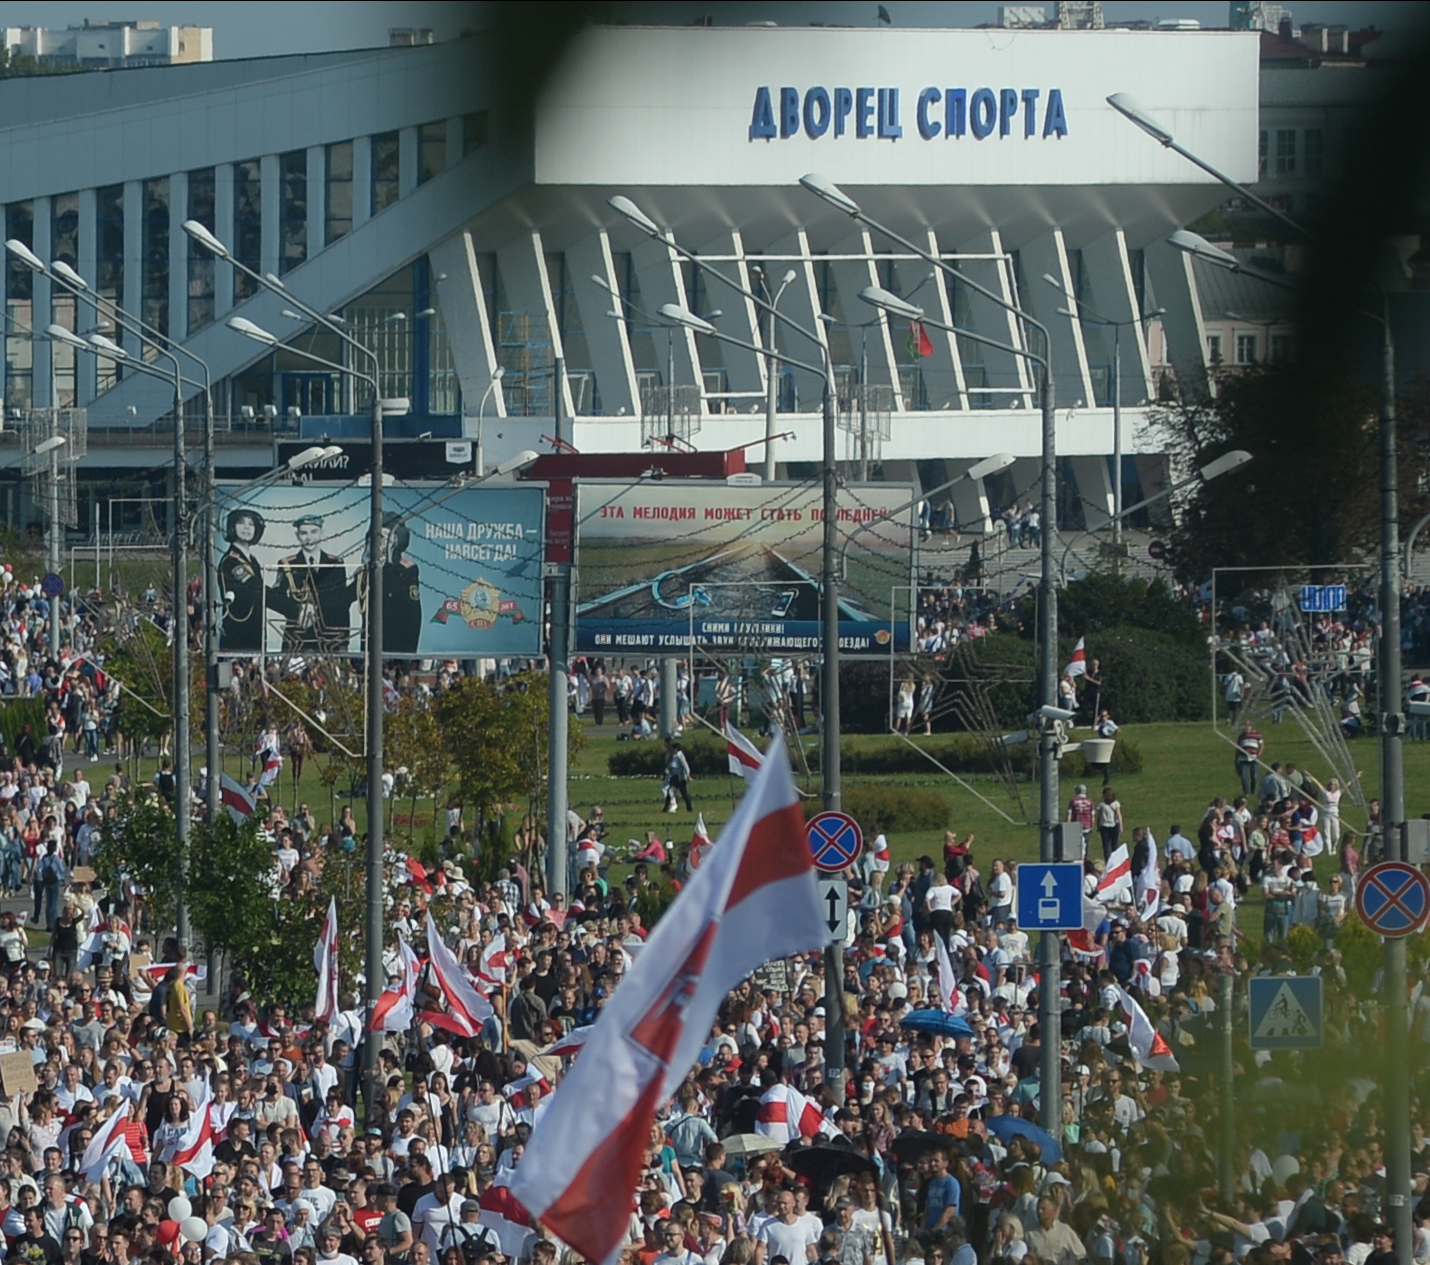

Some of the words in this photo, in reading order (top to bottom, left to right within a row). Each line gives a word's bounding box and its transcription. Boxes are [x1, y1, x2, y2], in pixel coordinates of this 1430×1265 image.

[748, 86, 903, 143] ДВОРЕЦ
[916, 86, 1069, 141] СПОРТА
[600, 505, 624, 519] ЭТА
[633, 505, 696, 521] МЕЛОДИЯ
[704, 506, 751, 521] МОЖЕТ
[760, 506, 802, 521] СТАТЬ
[425, 523, 464, 539] НАША
[467, 522, 523, 540] ДРУЖБА
[445, 544, 517, 562] НАВСЕГДА!
[446, 602, 458, 610] 65
[702, 622, 730, 633] СНИМИ
[595, 634, 611, 645] ОНИ
[616, 634, 655, 645] МЕШАЮТ
[838, 637, 869, 650] ОЕЗДА!
